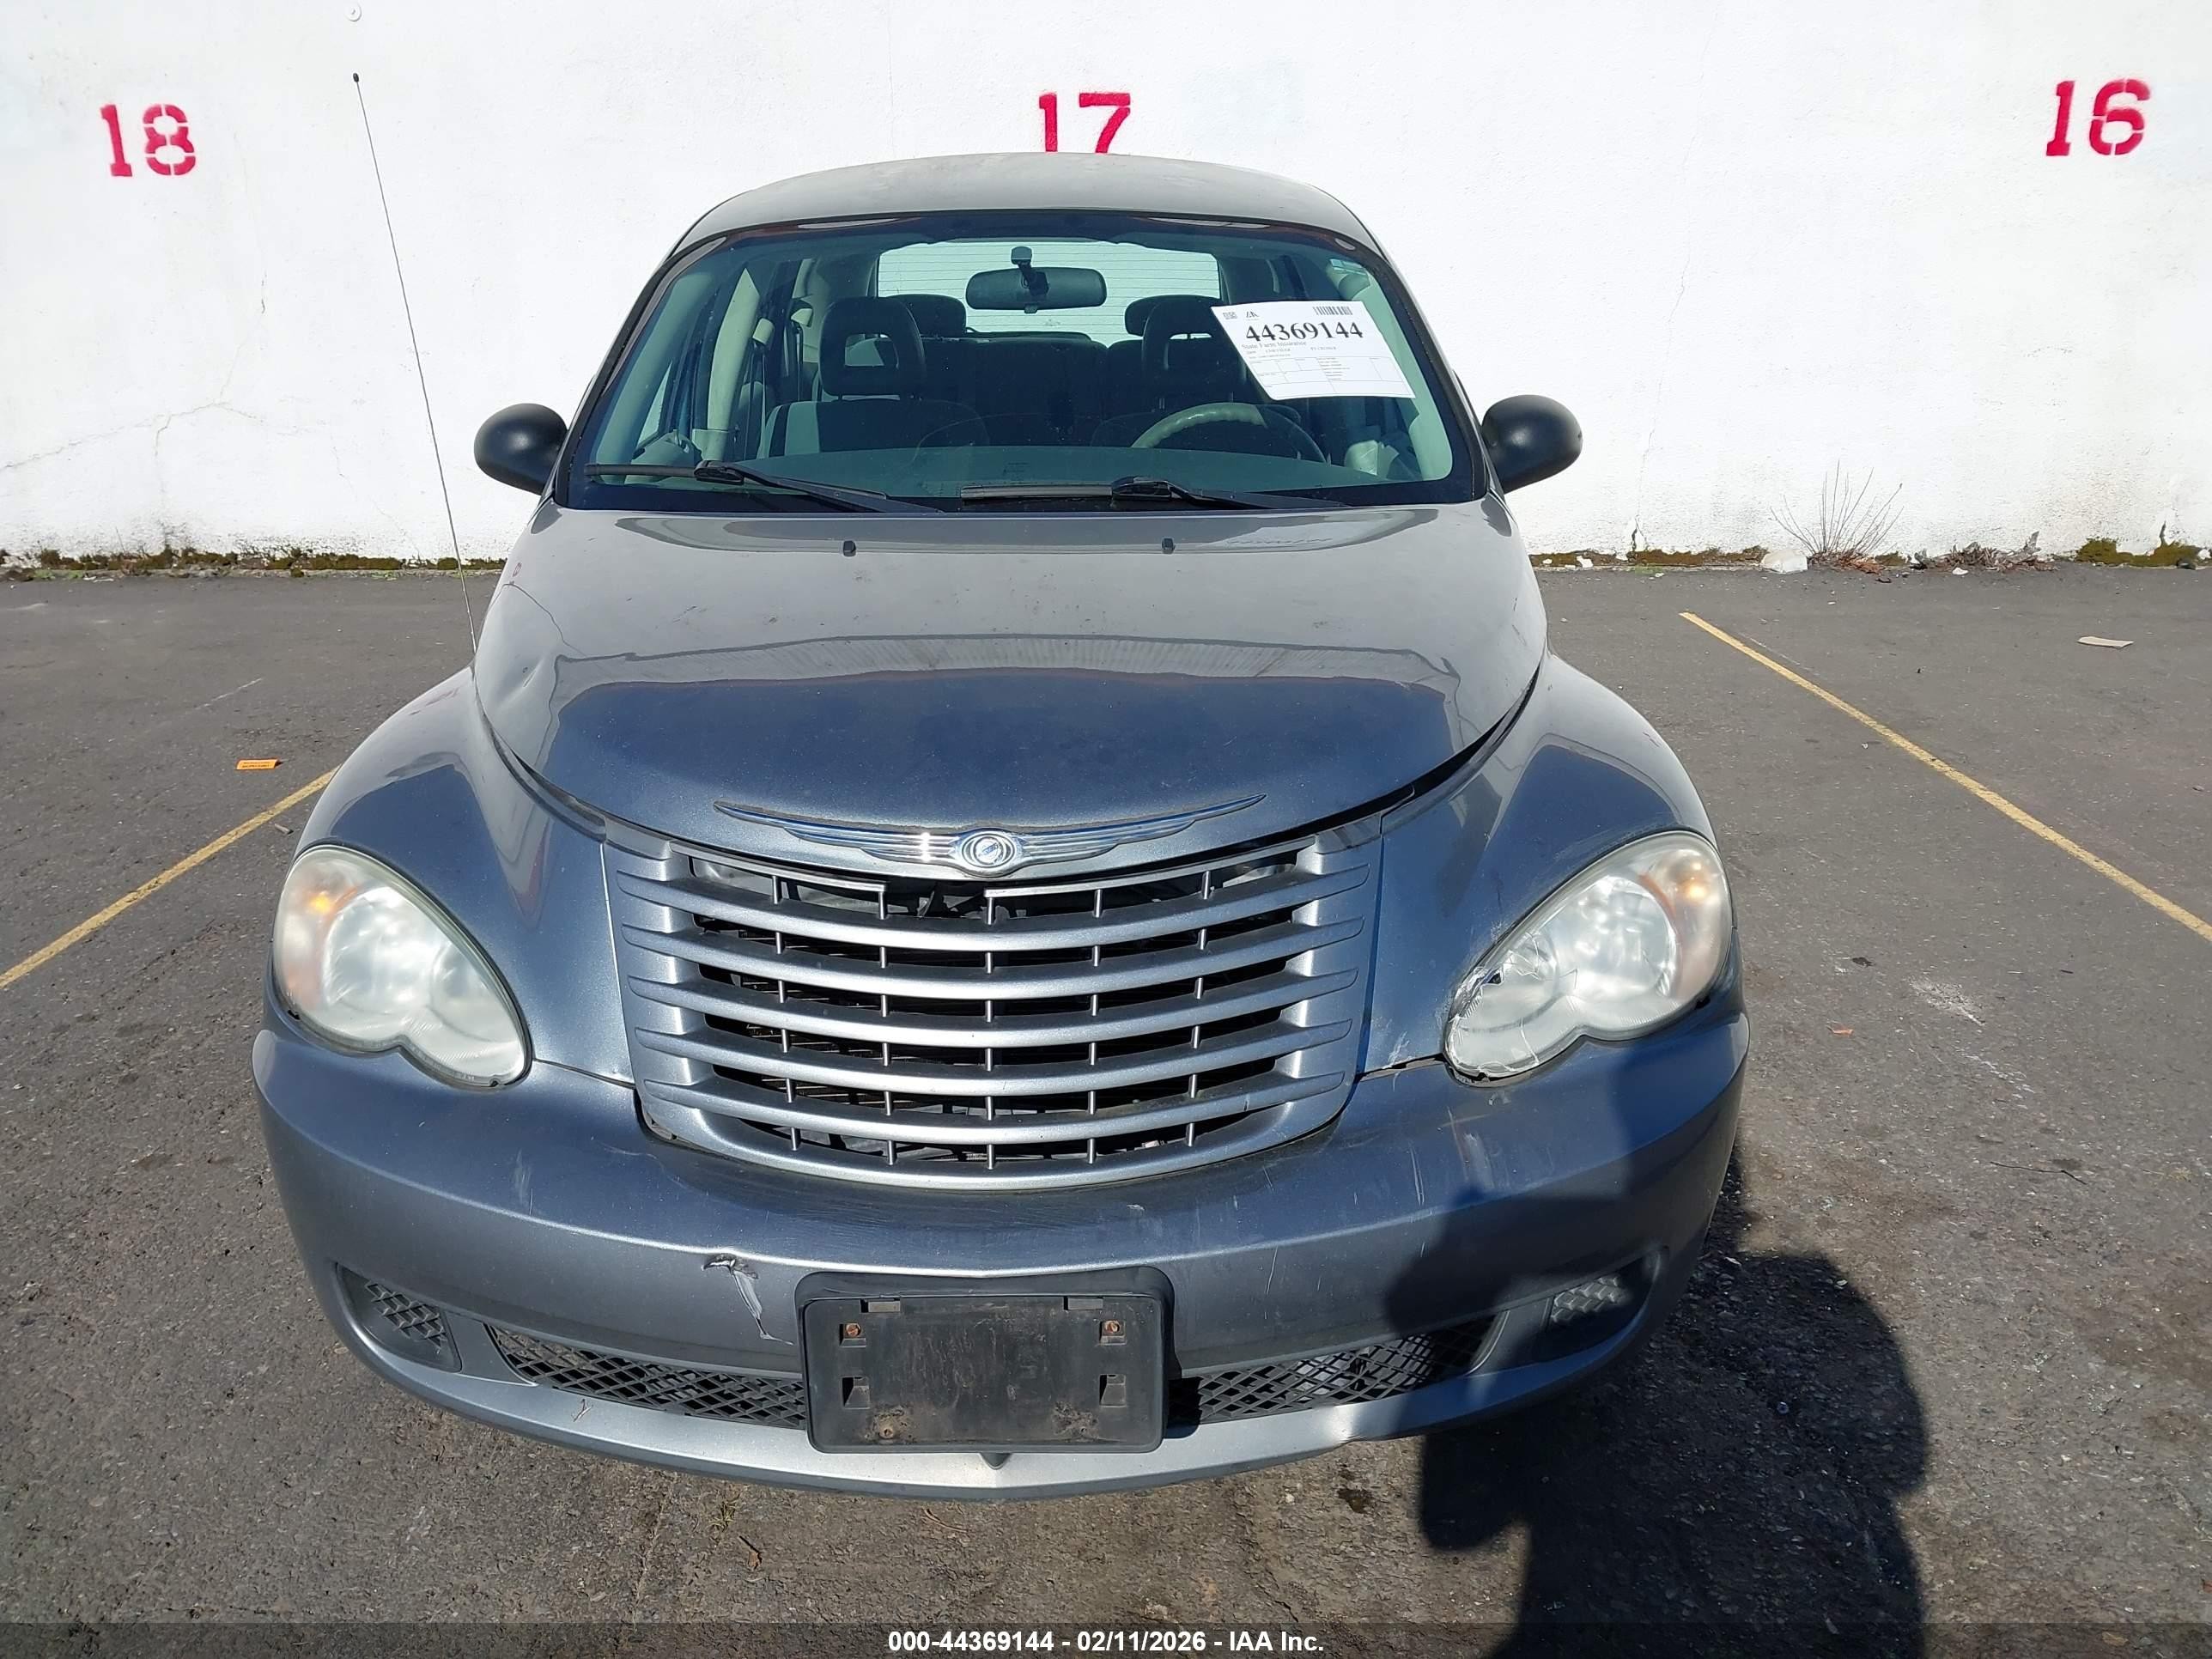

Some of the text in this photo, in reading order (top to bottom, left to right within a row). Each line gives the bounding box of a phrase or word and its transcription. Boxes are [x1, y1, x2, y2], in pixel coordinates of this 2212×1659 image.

[100, 104, 197, 177] 18
[1039, 92, 1131, 154] 17
[2045, 78, 2149, 156] 16
[1246, 322, 1364, 342] 44369144
